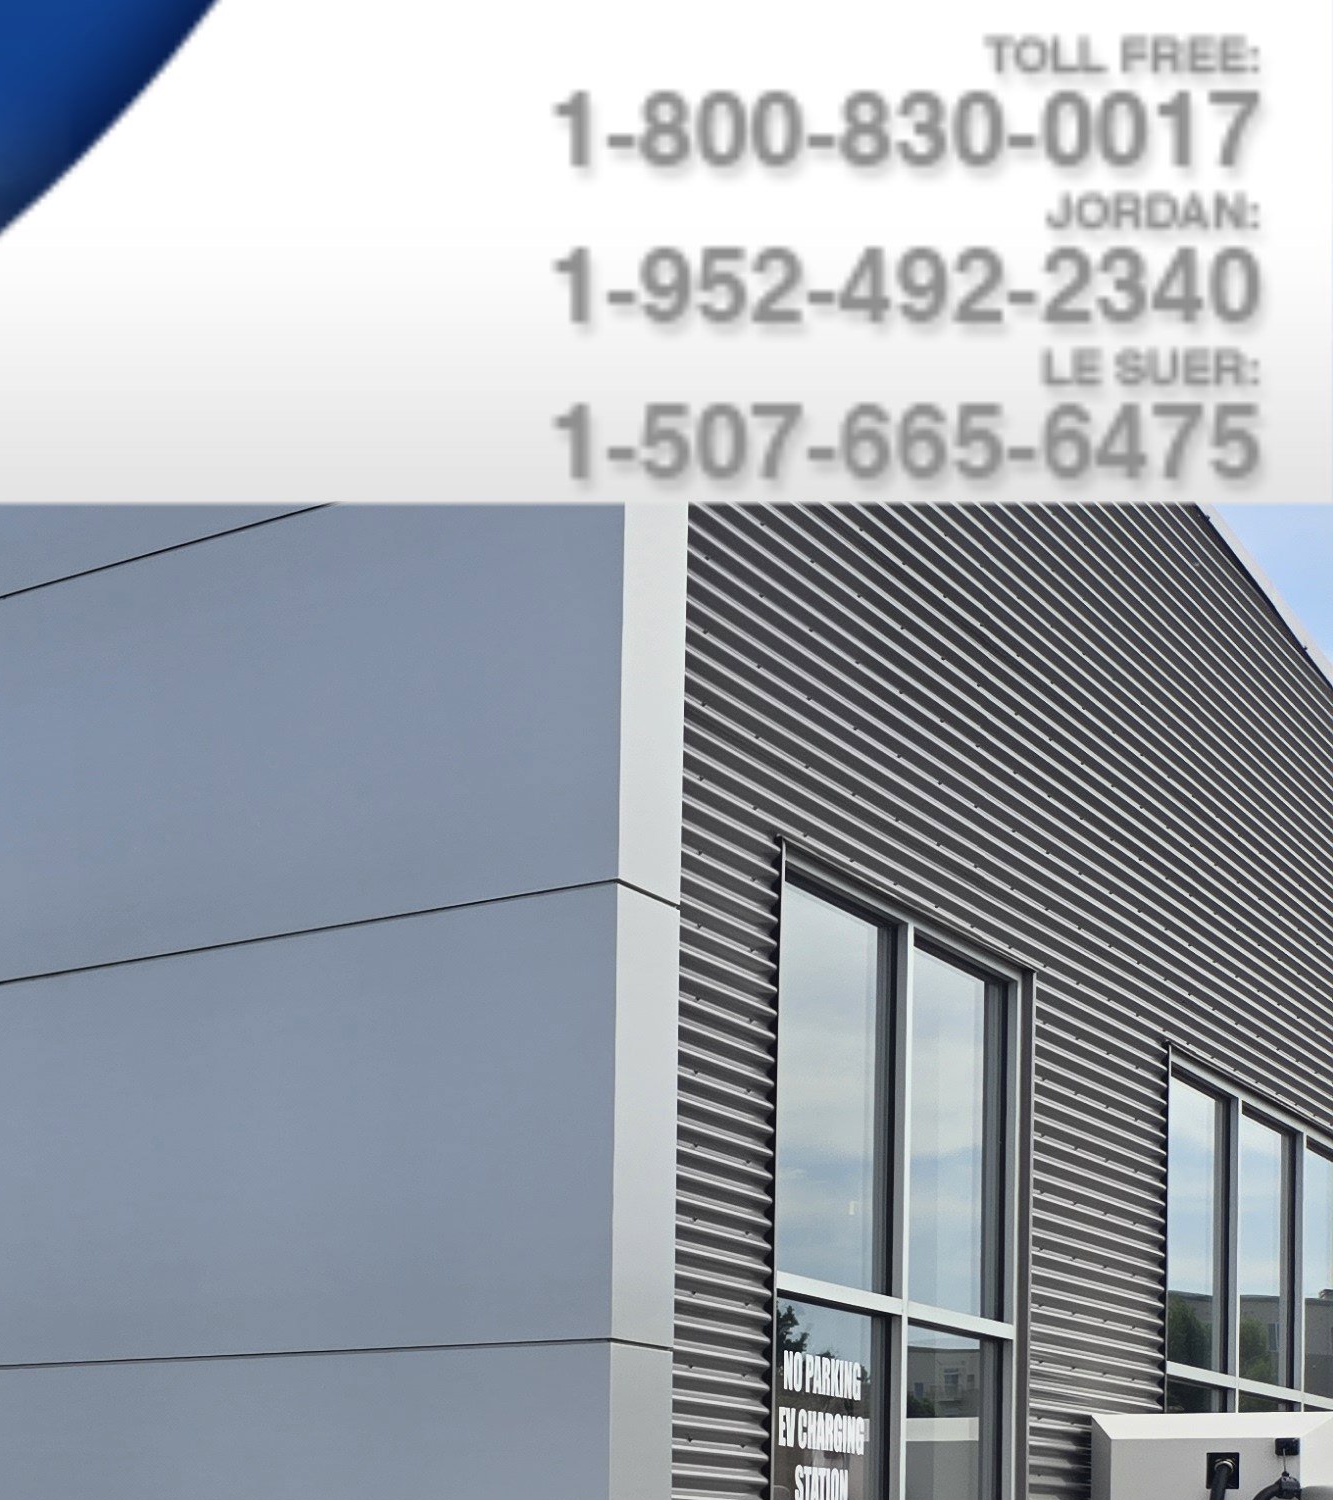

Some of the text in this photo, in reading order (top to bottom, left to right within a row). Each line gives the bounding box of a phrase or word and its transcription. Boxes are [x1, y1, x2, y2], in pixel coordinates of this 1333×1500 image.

[783, 1350, 862, 1401] NO PARKING
[778, 1407, 864, 1455] EV CHARGING
